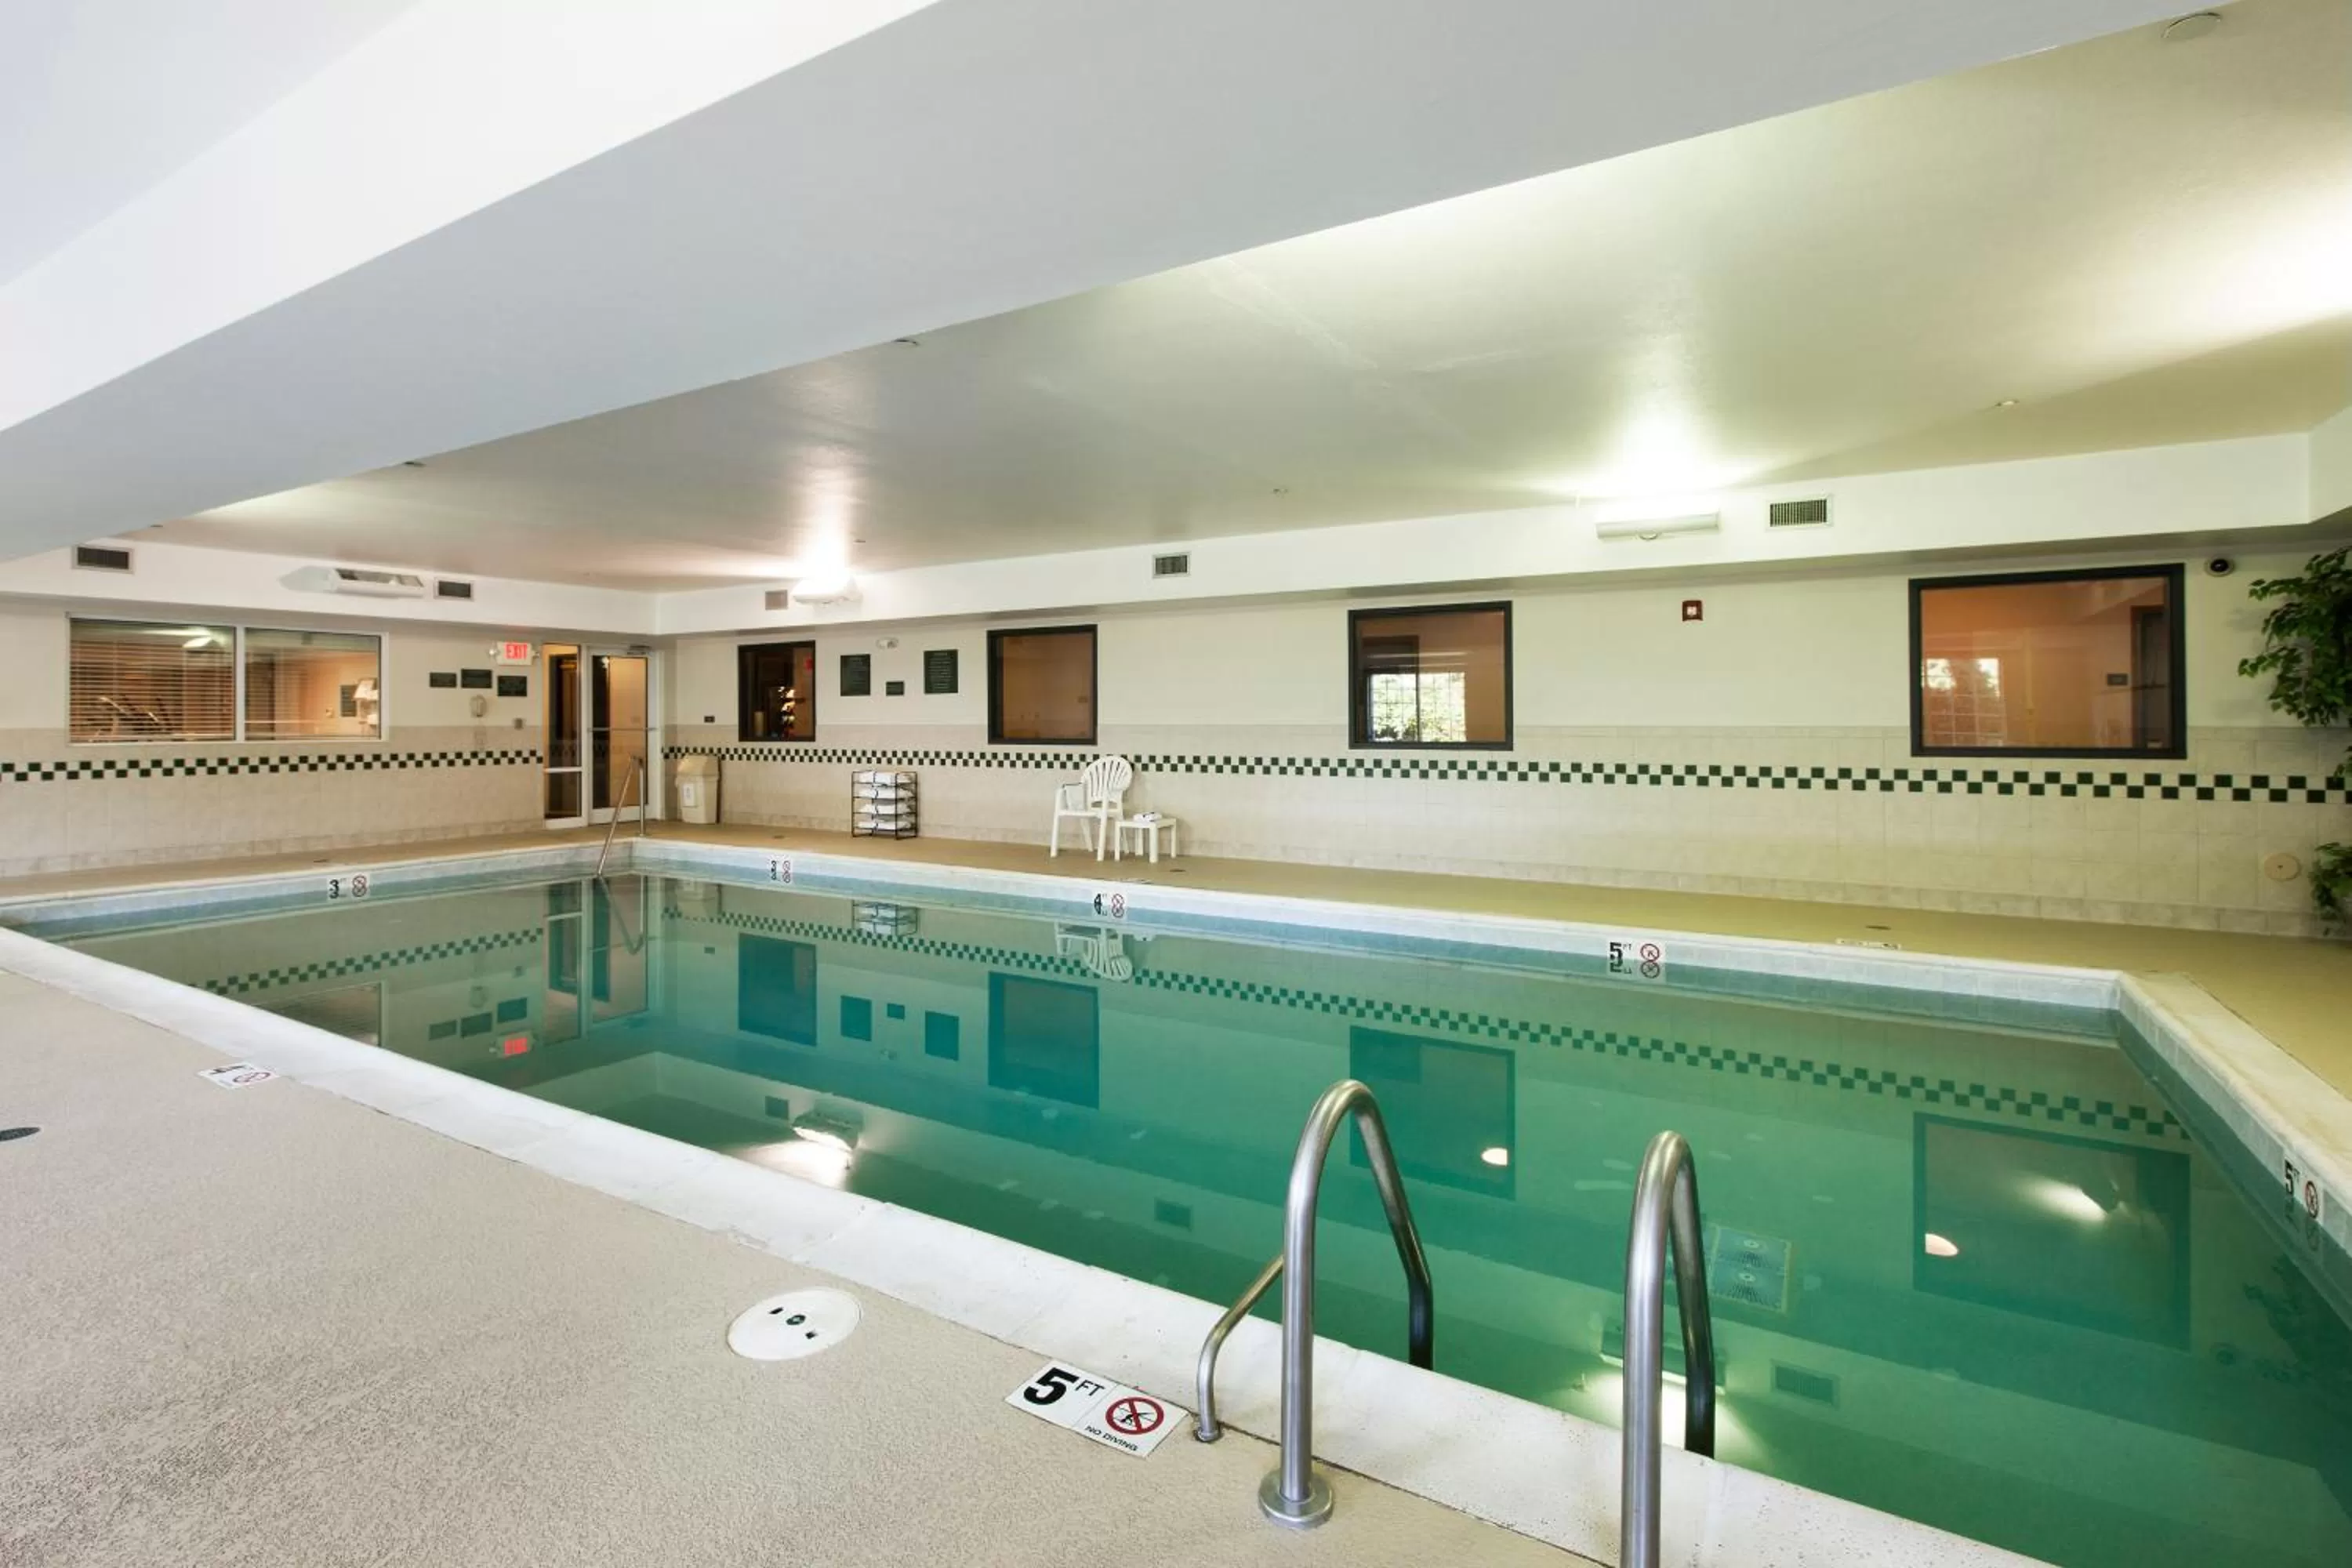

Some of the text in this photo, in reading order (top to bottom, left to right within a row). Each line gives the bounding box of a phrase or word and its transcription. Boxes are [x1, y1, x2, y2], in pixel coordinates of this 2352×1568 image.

[506, 643, 528, 659] EXIT
[1610, 942, 1623, 960] 5
[2285, 1160, 2294, 1196] 5
[1023, 1367, 1105, 1405] 5 FT
[1084, 1425, 1138, 1451] NO DIVING
